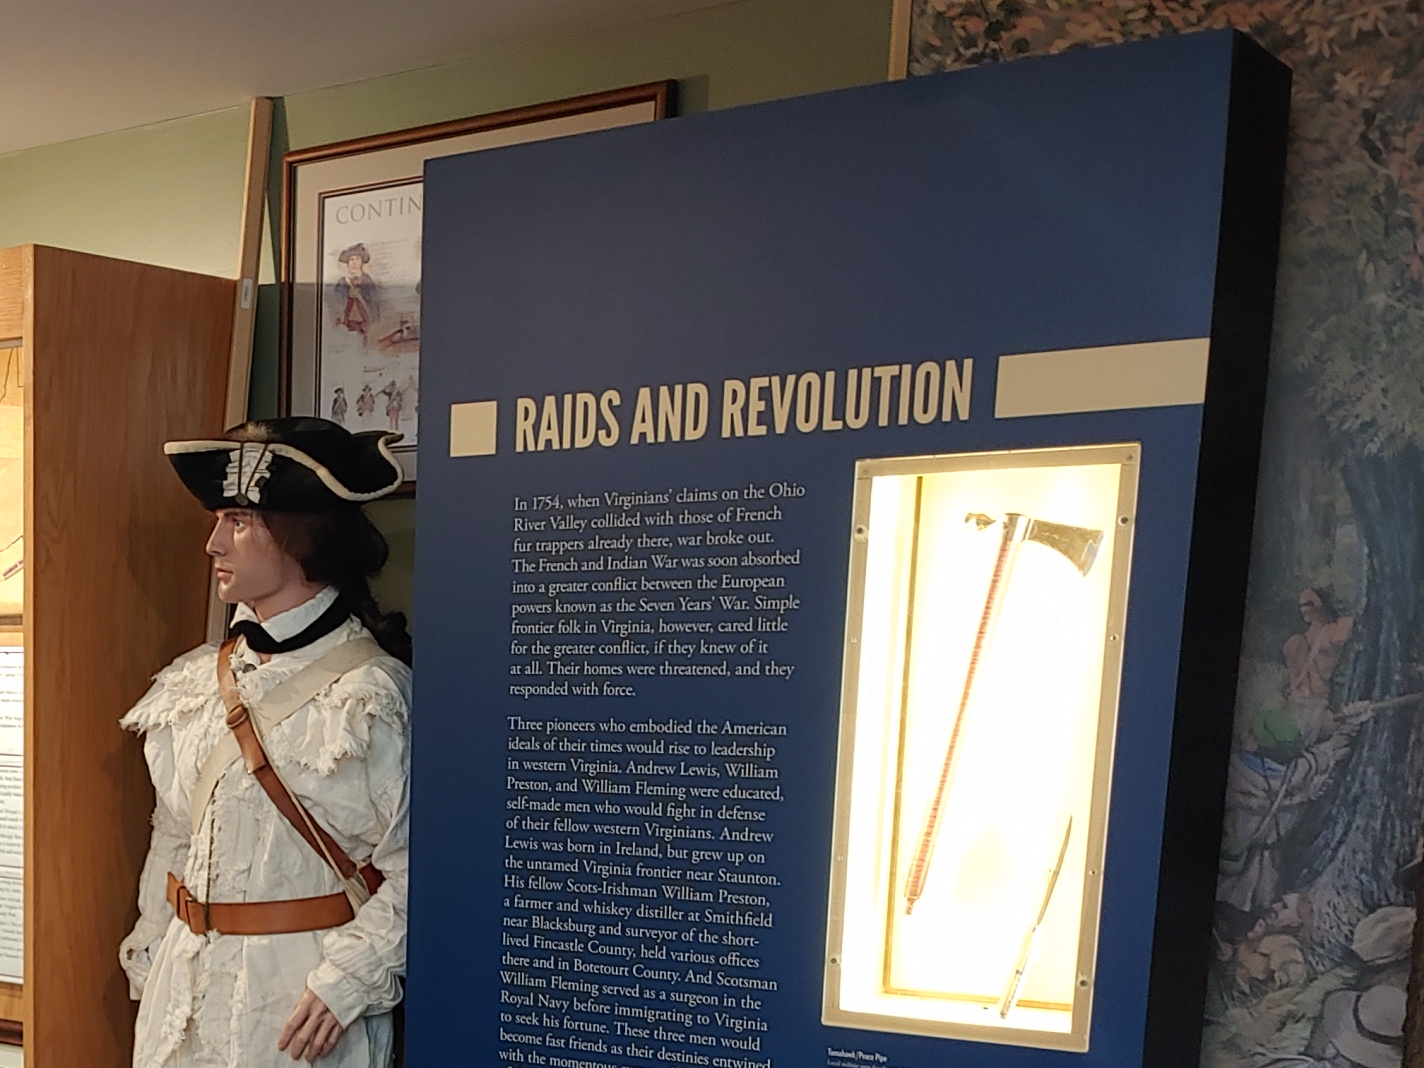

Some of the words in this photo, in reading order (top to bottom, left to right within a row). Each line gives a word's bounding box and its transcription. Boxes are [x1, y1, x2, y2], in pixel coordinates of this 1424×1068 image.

[515, 391, 620, 453] RAIDS
[631, 384, 709, 444] AND
[720, 358, 974, 438] REVOLUTION
[513, 496, 527, 510] In
[532, 493, 563, 510] 1754,
[566, 492, 599, 507] when
[675, 486, 717, 502] claims
[720, 489, 738, 500] on
[743, 483, 765, 499] the
[768, 480, 805, 497] Ohio
[513, 517, 546, 531] River
[548, 513, 587, 532] Valley
[590, 510, 640, 528] collided
[643, 509, 673, 525] with
[678, 508, 713, 524] those
[716, 506, 733, 522] of
[734, 504, 782, 521] French
[513, 536, 532, 552] fur
[535, 539, 584, 555] trappers
[586, 532, 633, 552] already
[636, 532, 672, 548] there,
[676, 535, 702, 545] war
[705, 528, 744, 545] broke
[746, 532, 774, 543] out.
[510, 557, 536, 572] The
[537, 555, 578, 571] French
[580, 554, 603, 570] and
[606, 554, 647, 570] Indian
[649, 553, 678, 568] War
[680, 557, 705, 567] was
[706, 555, 737, 567] soon
[740, 548, 800, 565] absorbed
[511, 579, 535, 593] into
[537, 583, 545, 592] a
[547, 581, 589, 597] greater
[590, 575, 637, 591] conflict
[640, 575, 692, 590] between
[696, 573, 717, 589] the
[720, 573, 784, 592] European
[510, 603, 551, 617] powers
[554, 598, 596, 612] known
[598, 602, 612, 612] as
[615, 596, 635, 611] the
[637, 596, 675, 611] Seven
[718, 595, 749, 610] War.
[753, 593, 800, 614] Simple
[510, 618, 554, 633] frontier
[557, 618, 581, 633] folk
[583, 619, 596, 633] in
[599, 618, 654, 637] Virginia,
[657, 617, 713, 633] however,
[717, 616, 753, 632] cared
[756, 615, 788, 631] little
[510, 639, 528, 654] for
[530, 639, 550, 654] the
[552, 643, 595, 658] greater
[597, 638, 649, 655] conflict,
[653, 638, 666, 654] if
[667, 638, 696, 657] they
[699, 638, 736, 653] knew
[739, 637, 756, 653] of
[757, 639, 768, 653] it
[509, 664, 521, 674] at
[523, 660, 542, 674] all.
[545, 660, 580, 674] Their
[582, 659, 622, 675] homes
[625, 665, 655, 675] were
[658, 659, 730, 676] threatened,
[733, 659, 760, 675] and
[764, 659, 794, 679] they
[509, 680, 568, 699] responded
[570, 680, 598, 695] with
[601, 680, 635, 696] force.
[506, 715, 543, 730] Three
[545, 717, 595, 737] pioneers
[598, 717, 626, 732] who
[628, 717, 692, 733] embodied
[696, 718, 718, 734] the
[720, 719, 787, 735] American
[507, 735, 540, 750] ideals
[542, 735, 558, 750] of
[558, 736, 587, 751] their
[589, 738, 622, 752] times
[624, 738, 664, 753] would
[667, 740, 690, 754] rise
[693, 744, 706, 754] to
[710, 739, 775, 761] leadership
[506, 756, 519, 769] in
[521, 760, 566, 771] western
[569, 757, 622, 776] Virginia.
[624, 759, 676, 774] Andrew
[678, 760, 720, 778] Lewis,
[723, 762, 778, 778] William
[506, 775, 551, 796] Preston,
[554, 777, 577, 792] and
[580, 777, 630, 794] William
[634, 779, 686, 800] Fleming
[688, 786, 719, 797] were
[721, 783, 784, 801] educated,
[505, 794, 561, 811] self-made
[563, 802, 590, 812] men
[593, 798, 620, 814] who
[623, 800, 662, 816] would
[665, 801, 696, 821] fight
[699, 804, 713, 818] in
[716, 803, 766, 820] defense
[501, 950, 530, 966] there
[531, 954, 554, 969] and
[557, 956, 569, 970] in
[572, 957, 629, 976] Botetourt
[631, 963, 681, 984] County.
[683, 968, 712, 984] And
[715, 970, 777, 991] Scotsman
[497, 1047, 524, 1062] with
[527, 1049, 546, 1064] the
[499, 1026, 542, 1045] become
[544, 1031, 565, 1048] fast
[568, 1034, 607, 1053] friends
[609, 1044, 623, 1054] as
[625, 1041, 654, 1058] their
[656, 1045, 709, 1065] destinies
